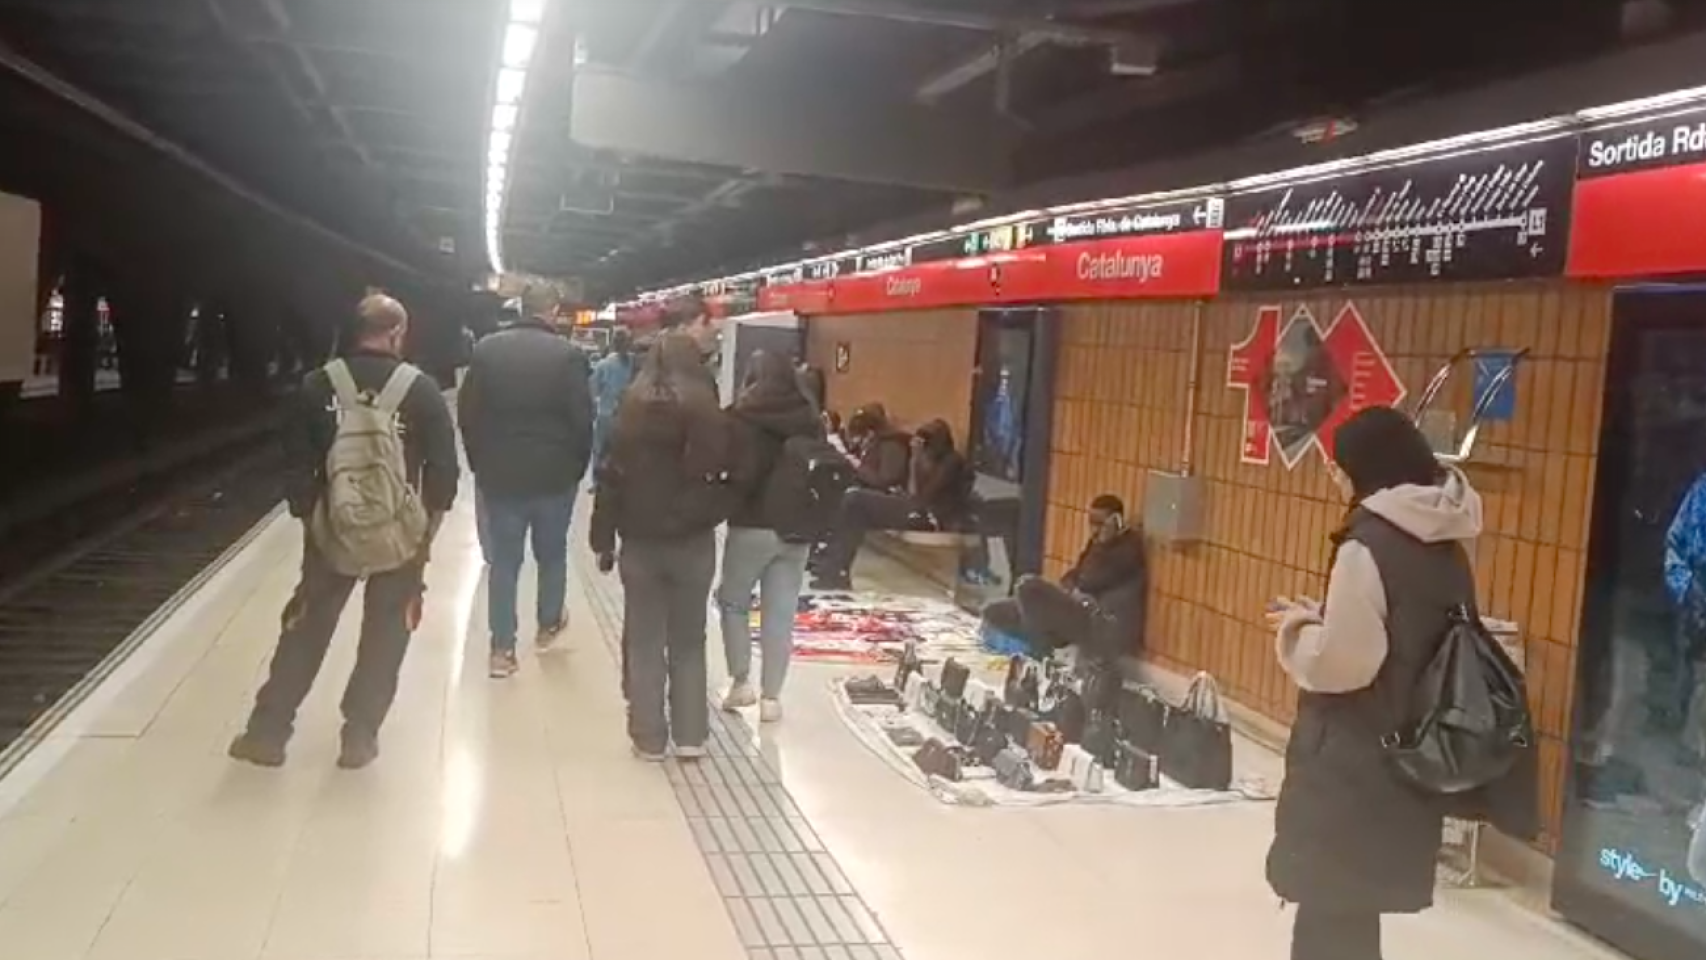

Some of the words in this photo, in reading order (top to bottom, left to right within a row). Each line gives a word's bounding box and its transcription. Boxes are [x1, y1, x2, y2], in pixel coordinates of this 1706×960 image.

[1588, 131, 1666, 167] Sortida
[1672, 122, 1706, 154] Rd
[1077, 249, 1164, 283] Catalunya
[1600, 848, 1657, 880] style
[1659, 868, 1683, 906] by
